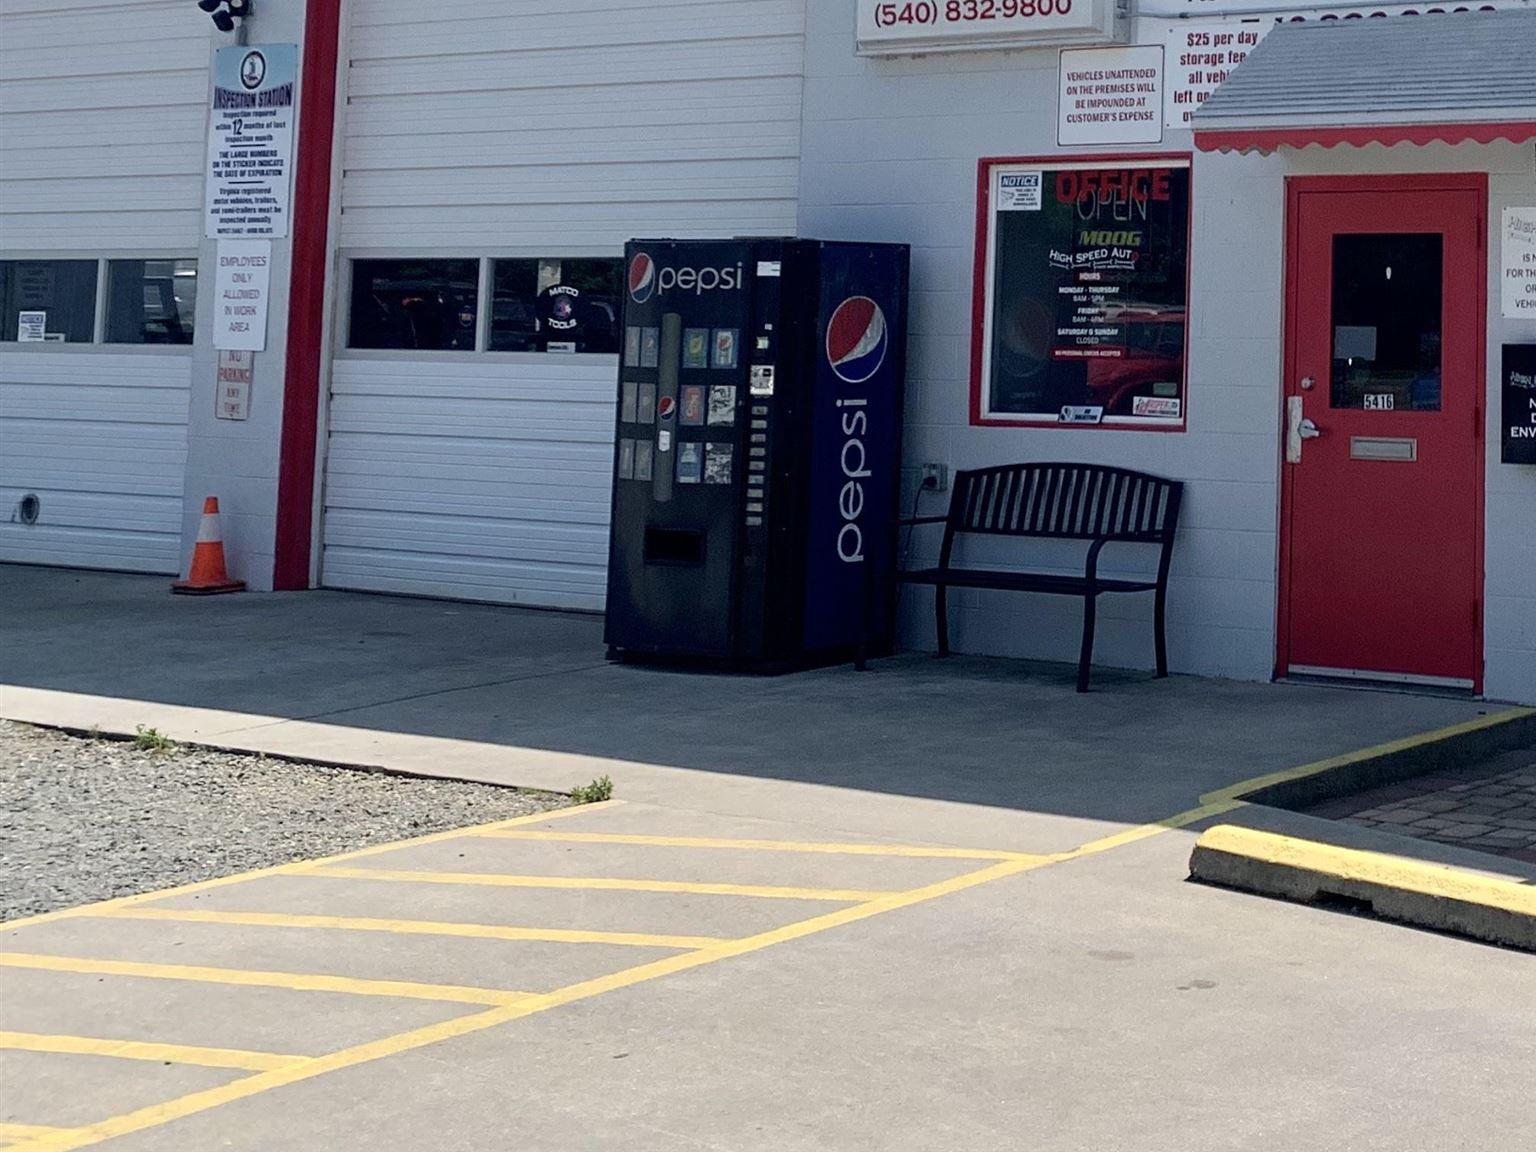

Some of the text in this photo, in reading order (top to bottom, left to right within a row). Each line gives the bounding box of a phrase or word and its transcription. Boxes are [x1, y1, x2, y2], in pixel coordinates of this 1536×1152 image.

[875, 0, 937, 28] (540)
[1187, 31, 1258, 47] $25 per day
[1180, 52, 1224, 66] storage
[1066, 68, 1156, 81] VEHICLES UNATTENDED
[1189, 71, 1202, 84] all
[213, 81, 293, 109] INSPECTION STATION
[1066, 83, 1155, 96] ON THE PREMISES WILL
[1075, 97, 1146, 109] BE IMPOUNDED AT
[1174, 90, 1192, 103] left
[1066, 111, 1154, 123] CUSTOMER'S EXPENSE
[232, 118, 243, 135] 12
[1002, 176, 1037, 186] NOTICE
[1055, 169, 1170, 203] OFFICE
[1077, 184, 1147, 221] OPEN
[1080, 231, 1142, 246] MOOG
[220, 256, 267, 267] EMPLOYEES
[1049, 249, 1072, 262] HIGH
[1076, 249, 1108, 263] SPEED
[1522, 254, 1530, 263] IS
[231, 273, 254, 283] ONLY
[657, 262, 743, 295] pepsi
[1506, 269, 1523, 278] FOR
[223, 289, 260, 299] ALLOWED
[549, 286, 579, 297] MATCO
[1525, 284, 1536, 293] OR
[224, 306, 257, 316] IN WORK
[229, 322, 250, 332] AREA
[548, 317, 578, 329] TOOLS
[229, 351, 241, 362] NO
[219, 368, 250, 382] PARKING
[1365, 395, 1392, 408] 5416
[837, 399, 872, 563] pepsi
